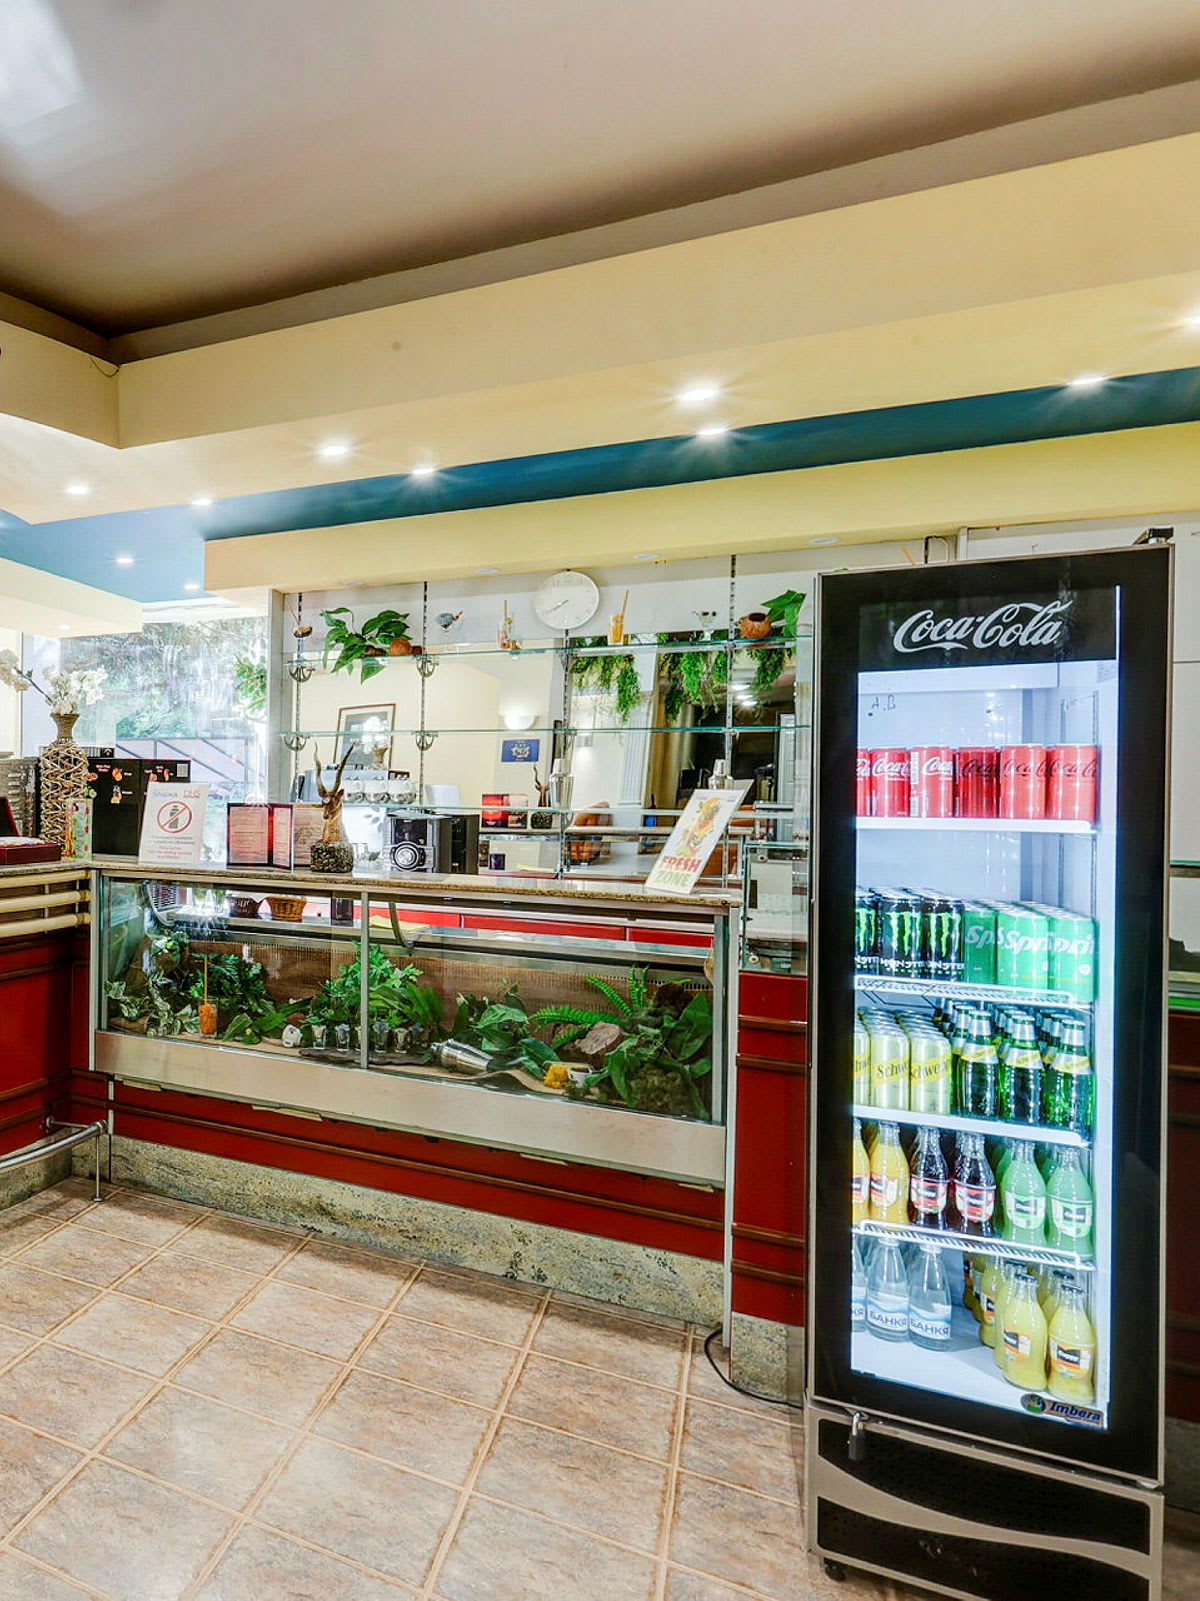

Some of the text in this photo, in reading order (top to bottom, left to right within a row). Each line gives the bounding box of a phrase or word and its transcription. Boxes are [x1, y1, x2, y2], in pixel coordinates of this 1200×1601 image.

[892, 599, 1074, 654] Coca-Cola
[661, 855, 703, 873] FRESH
[869, 1310, 907, 1327] БАНКЯ
[910, 1318, 949, 1336] БАНКЯ
[1050, 1400, 1101, 1421] Imbera
